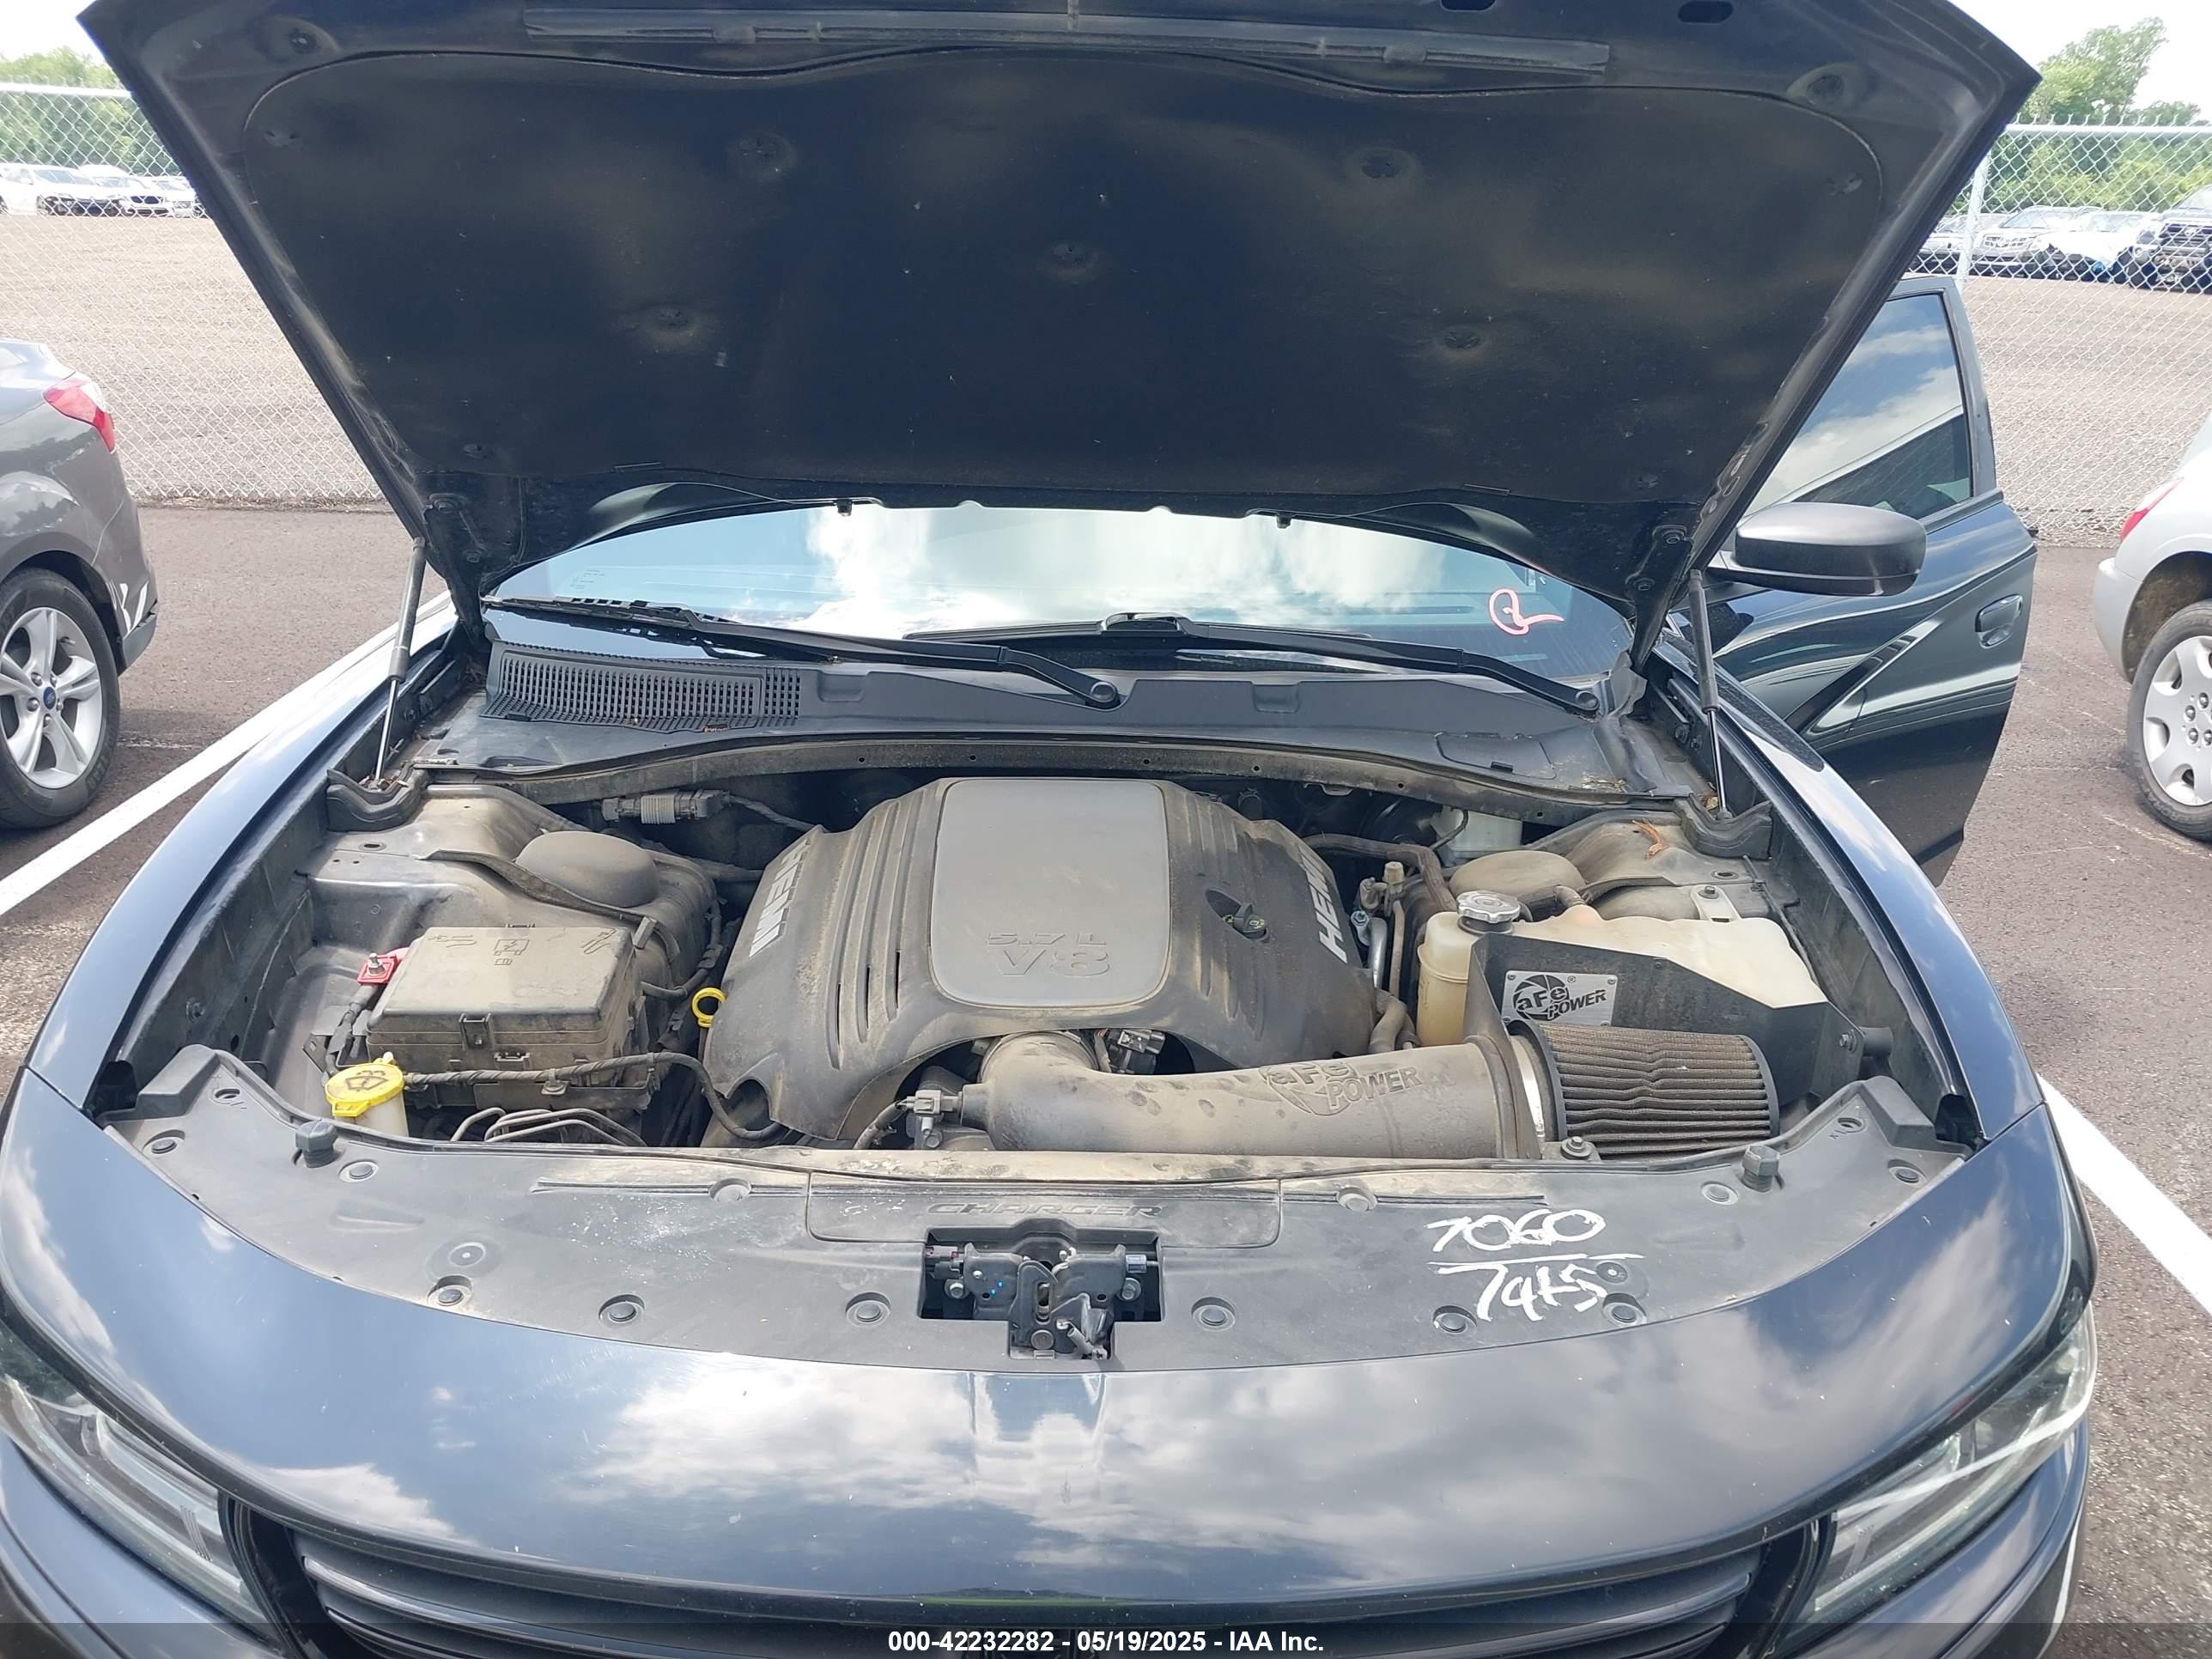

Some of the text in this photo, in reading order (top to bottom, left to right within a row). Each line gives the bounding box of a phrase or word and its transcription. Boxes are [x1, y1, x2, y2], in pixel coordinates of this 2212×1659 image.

[748, 838, 811, 958] HEMI
[1297, 842, 1348, 963] HEMI
[997, 947, 1111, 978] V8
[1516, 987, 1607, 1020] aFe POWER
[1327, 1067, 1423, 1109] POWER
[927, 1203, 1163, 1218] CHARGER
[1424, 1208, 1606, 1251] 7060
